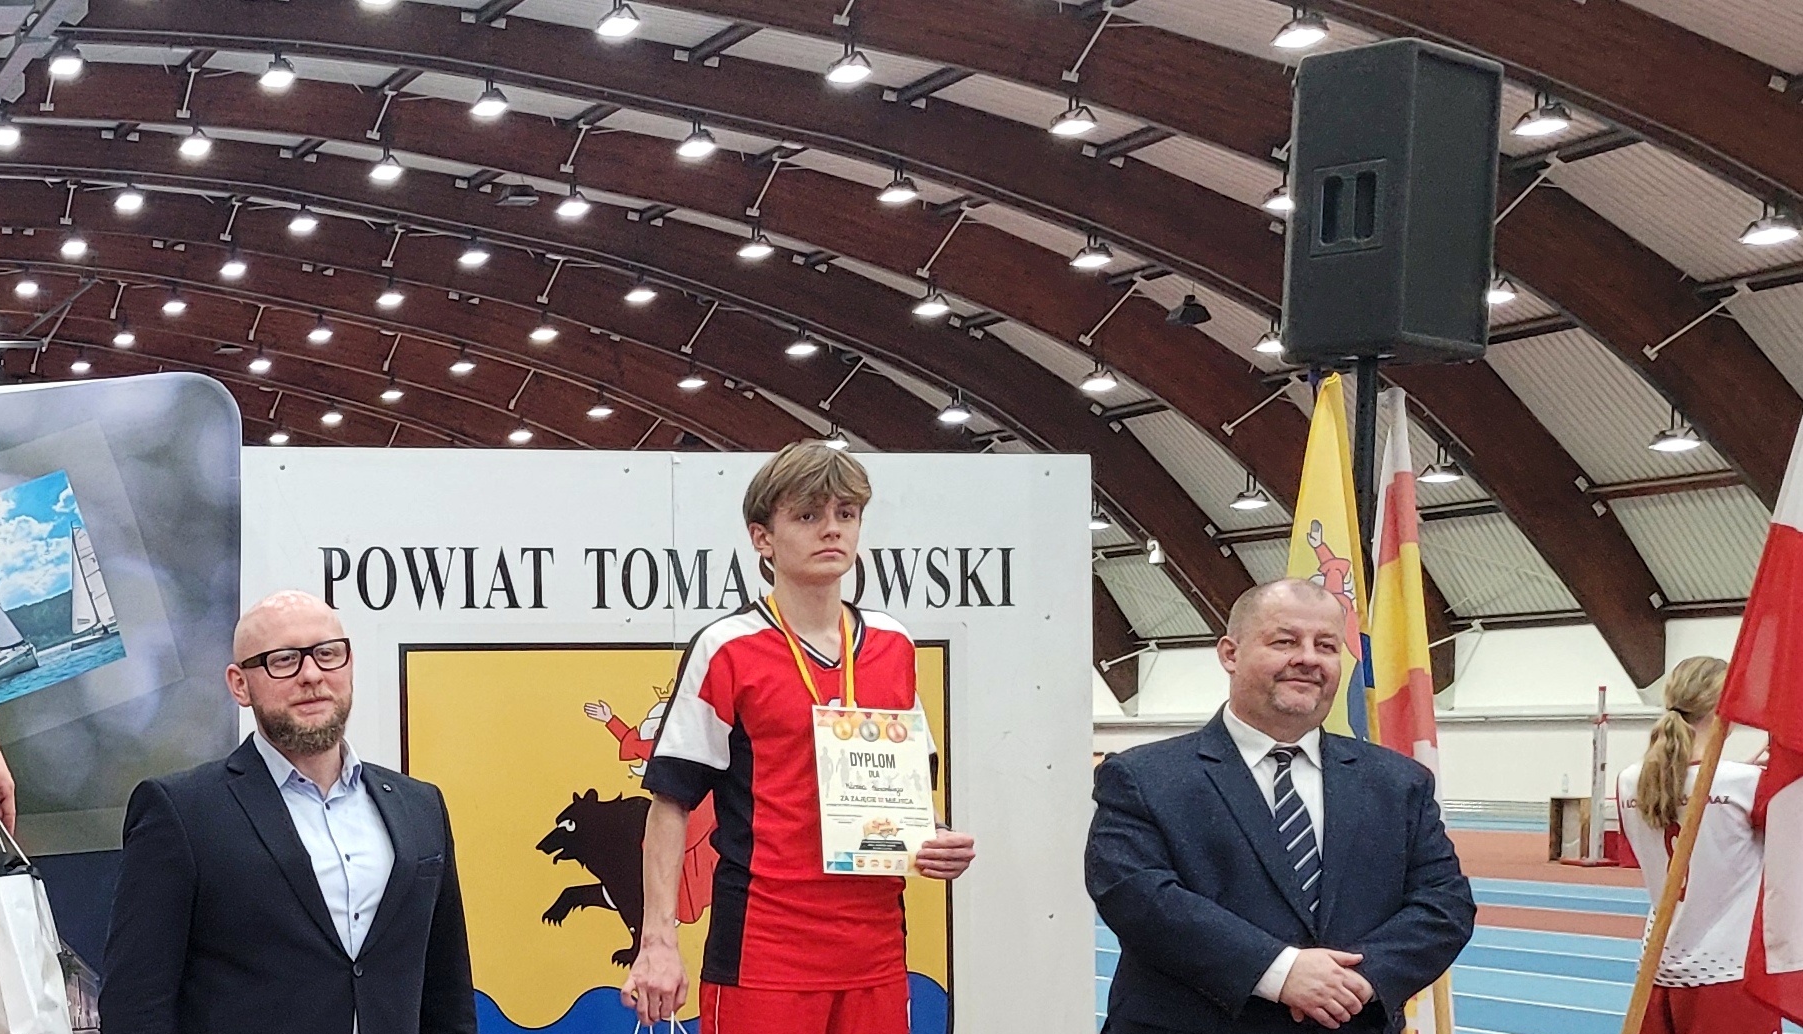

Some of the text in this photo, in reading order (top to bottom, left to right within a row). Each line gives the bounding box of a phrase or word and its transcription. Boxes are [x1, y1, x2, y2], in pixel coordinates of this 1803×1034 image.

[318, 546, 1015, 610] POWIAT TOMAWSKI
[849, 751, 896, 769] DYPLOM
[868, 770, 880, 779] DLA
